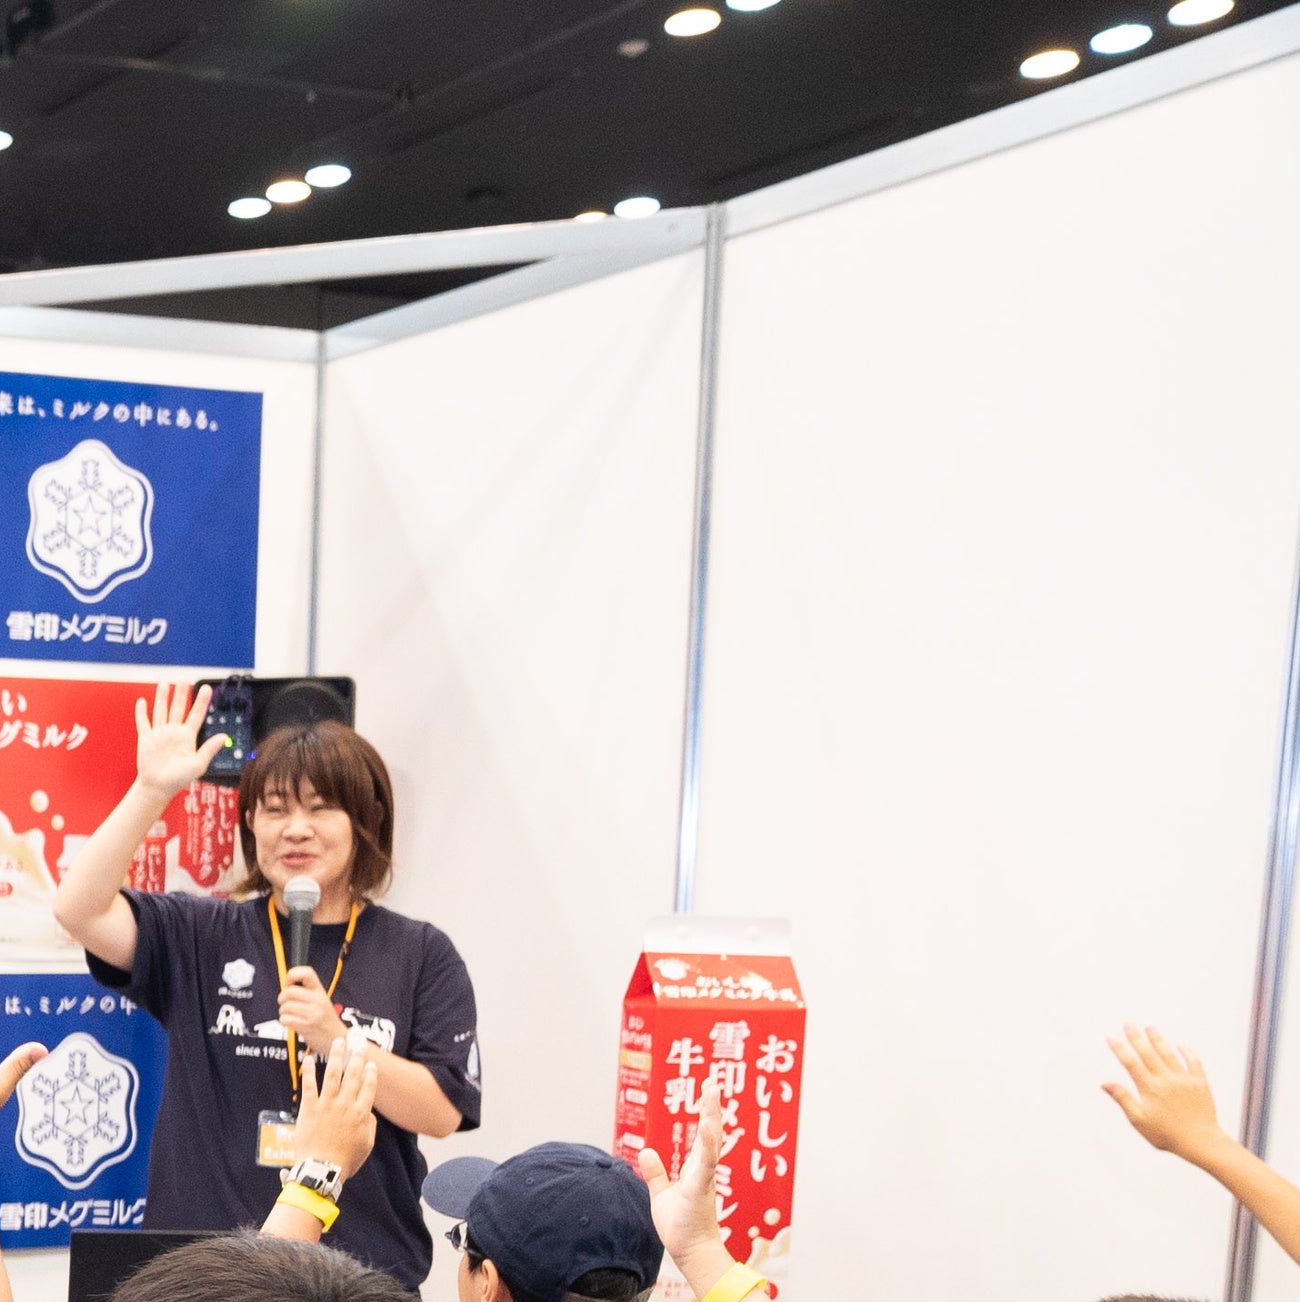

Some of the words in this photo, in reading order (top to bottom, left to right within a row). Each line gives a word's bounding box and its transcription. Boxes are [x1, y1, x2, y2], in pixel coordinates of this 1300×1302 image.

[6, 610, 168, 645] 雪印メグミルク
[235, 1043, 261, 1058] since
[663, 1037, 704, 1115] 牛乳
[751, 1034, 798, 1183] おいしい
